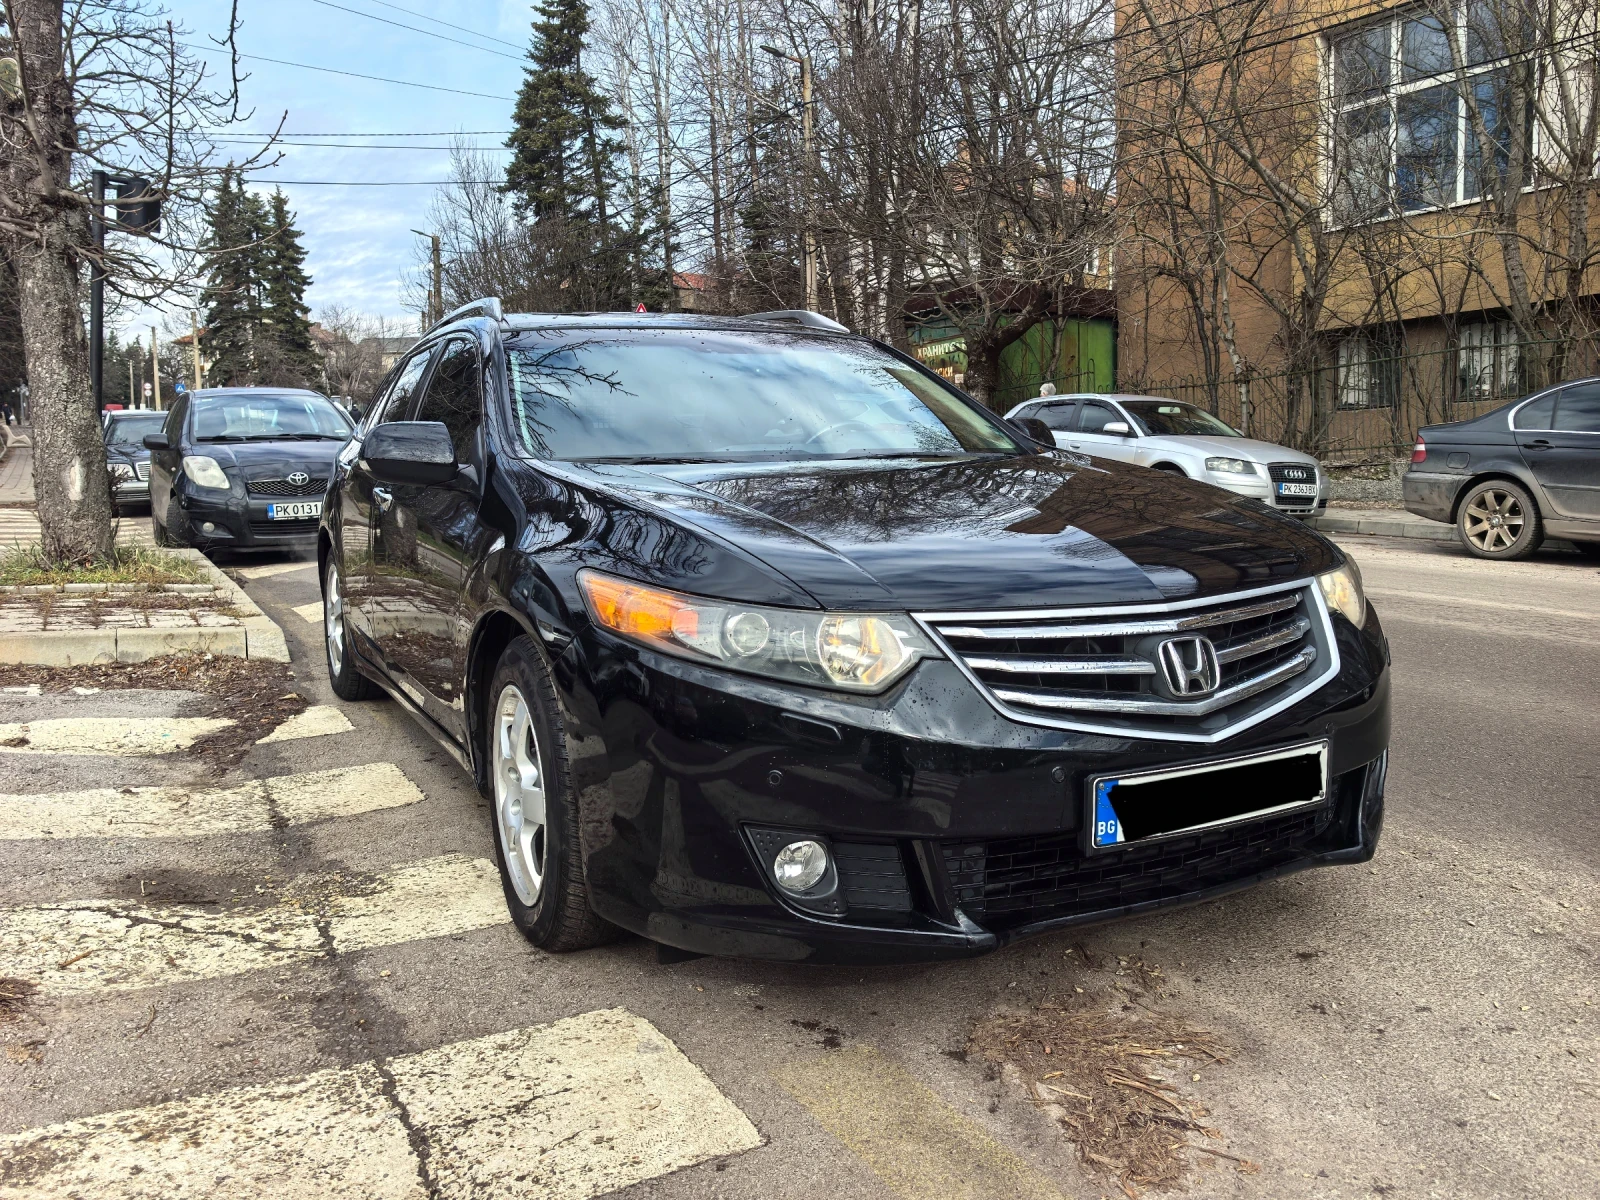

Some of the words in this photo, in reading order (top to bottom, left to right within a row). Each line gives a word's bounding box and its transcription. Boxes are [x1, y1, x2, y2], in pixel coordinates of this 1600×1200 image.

[275, 505, 291, 516] PK
[292, 503, 318, 515] 0131
[1097, 819, 1116, 836] BG
